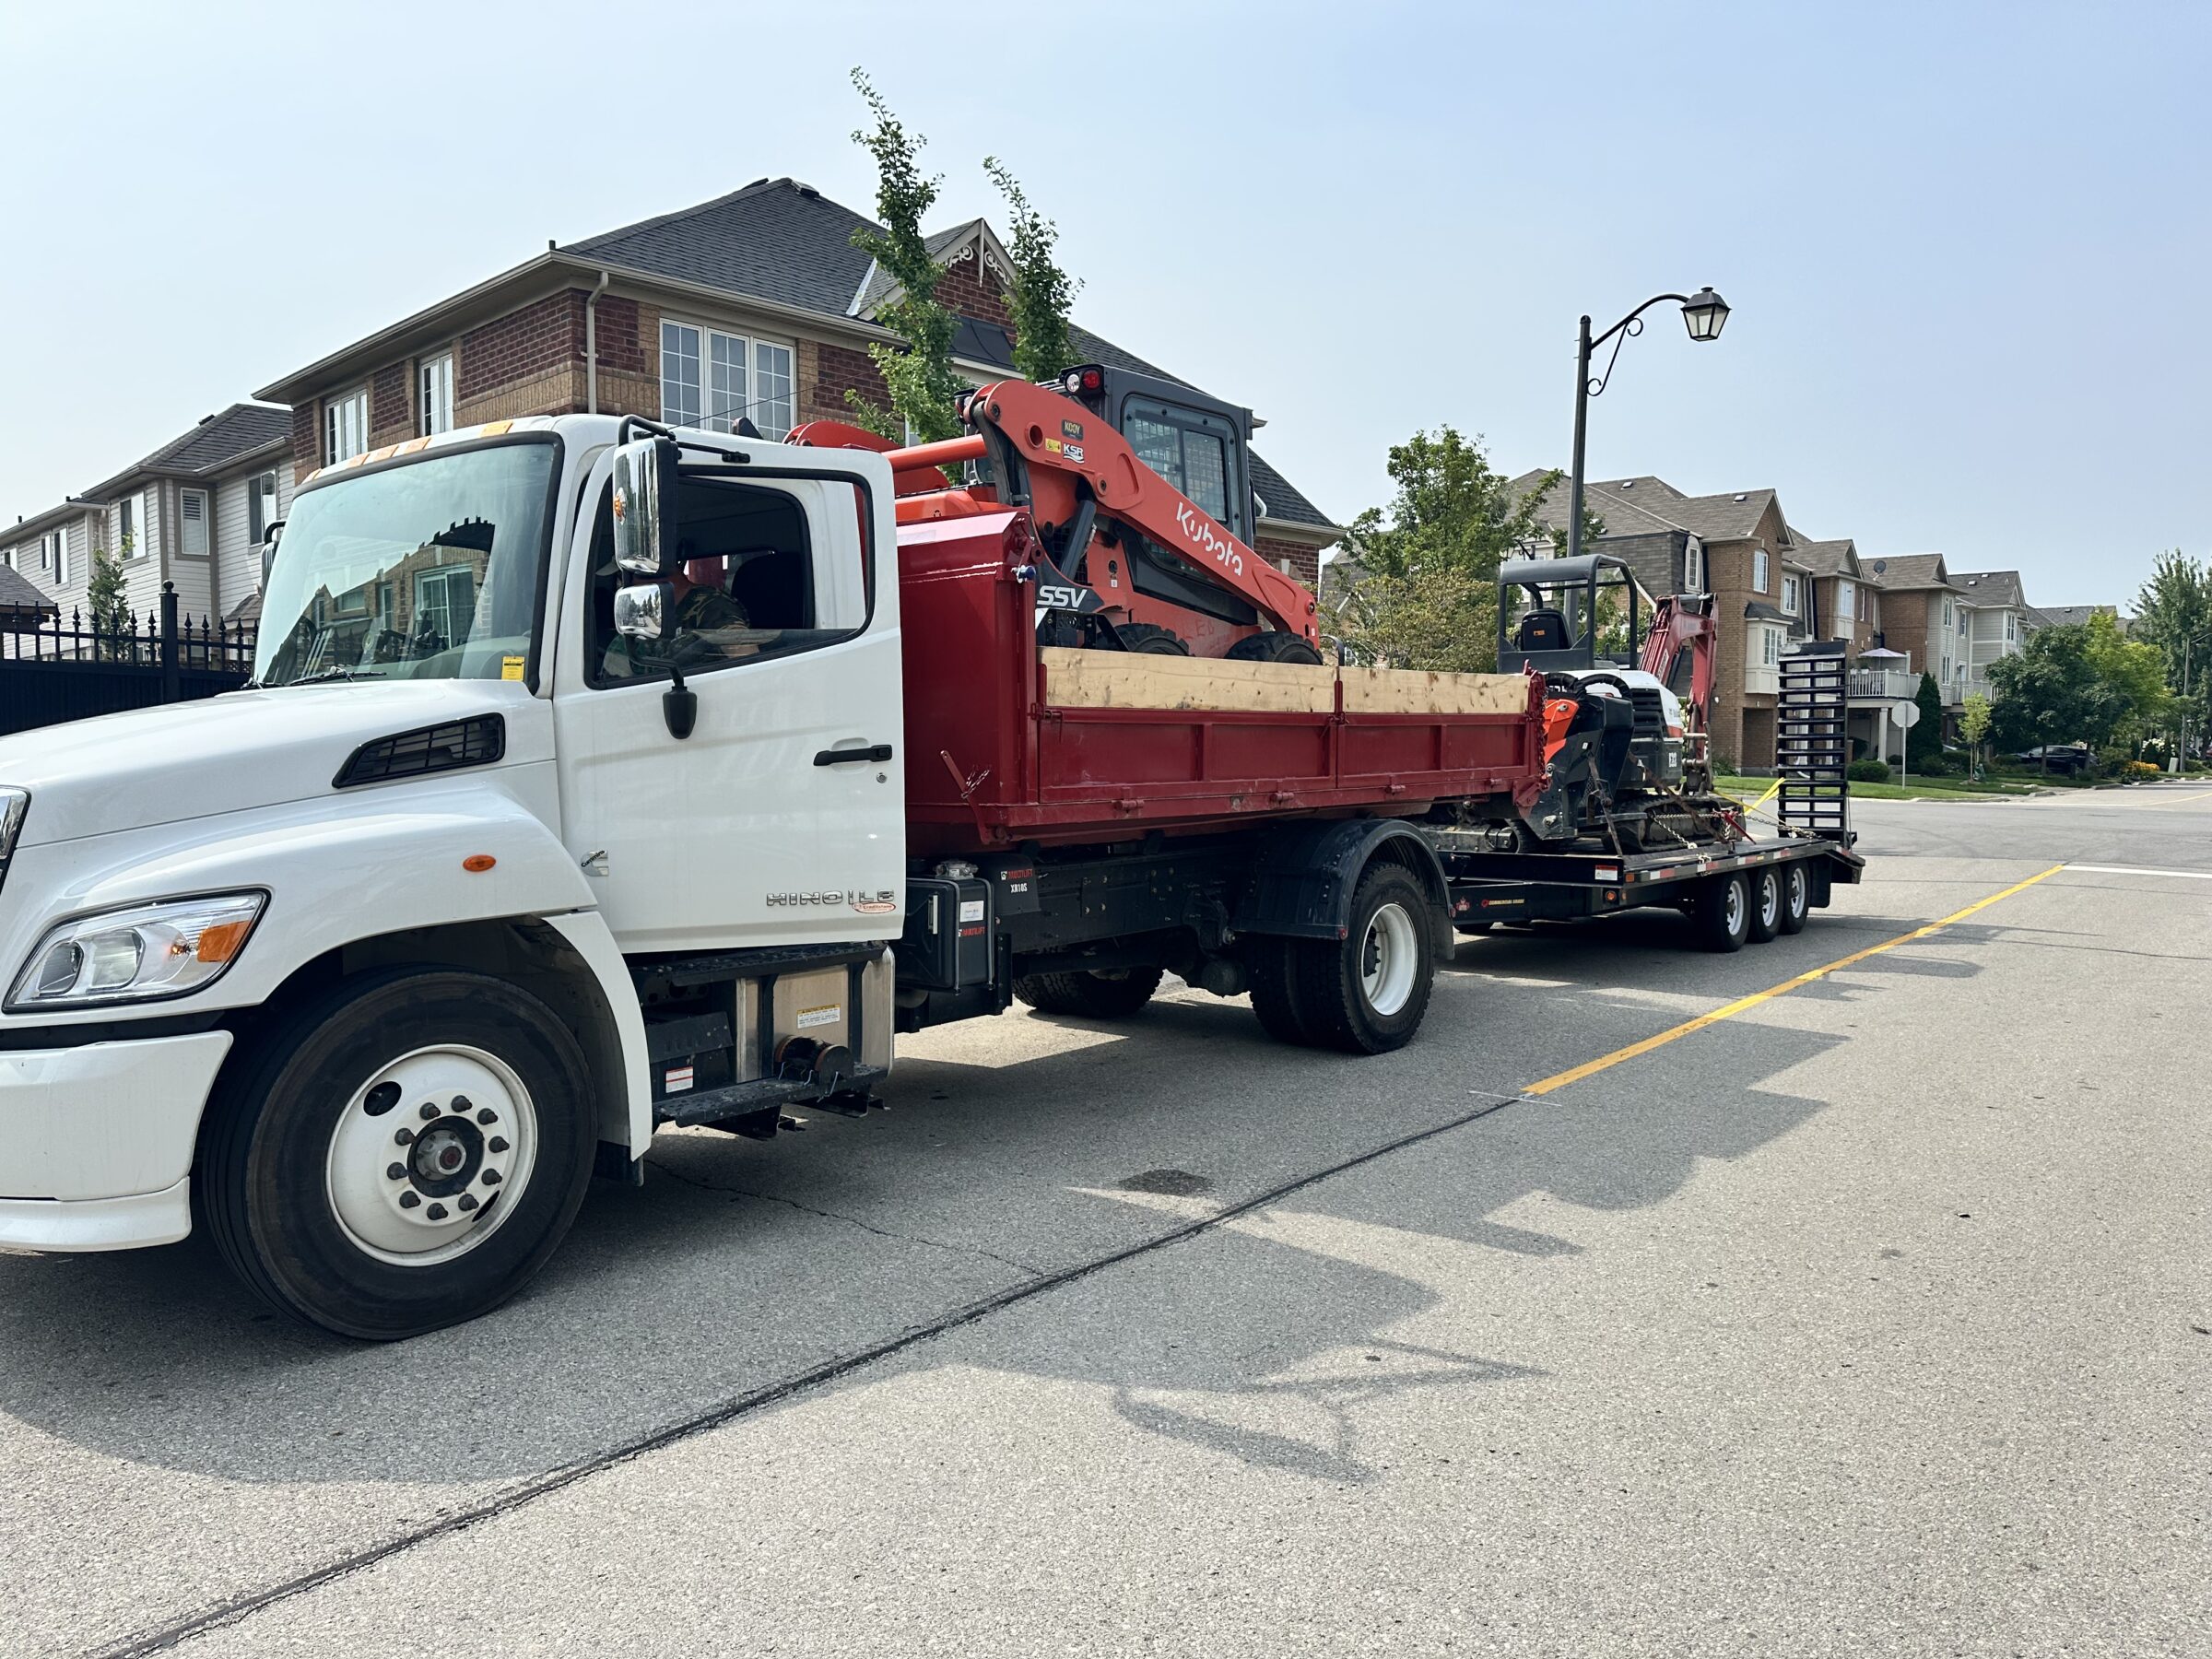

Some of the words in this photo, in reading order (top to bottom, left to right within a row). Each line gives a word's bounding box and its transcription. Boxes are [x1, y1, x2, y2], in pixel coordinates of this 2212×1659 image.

[1063, 442, 1084, 457] KSR
[1176, 501, 1242, 577] Kubota
[1037, 585, 1088, 608] SSV
[581, 850, 606, 867] Cummins
[1007, 869, 1033, 880] MULTILIFT
[766, 890, 843, 906] HINO
